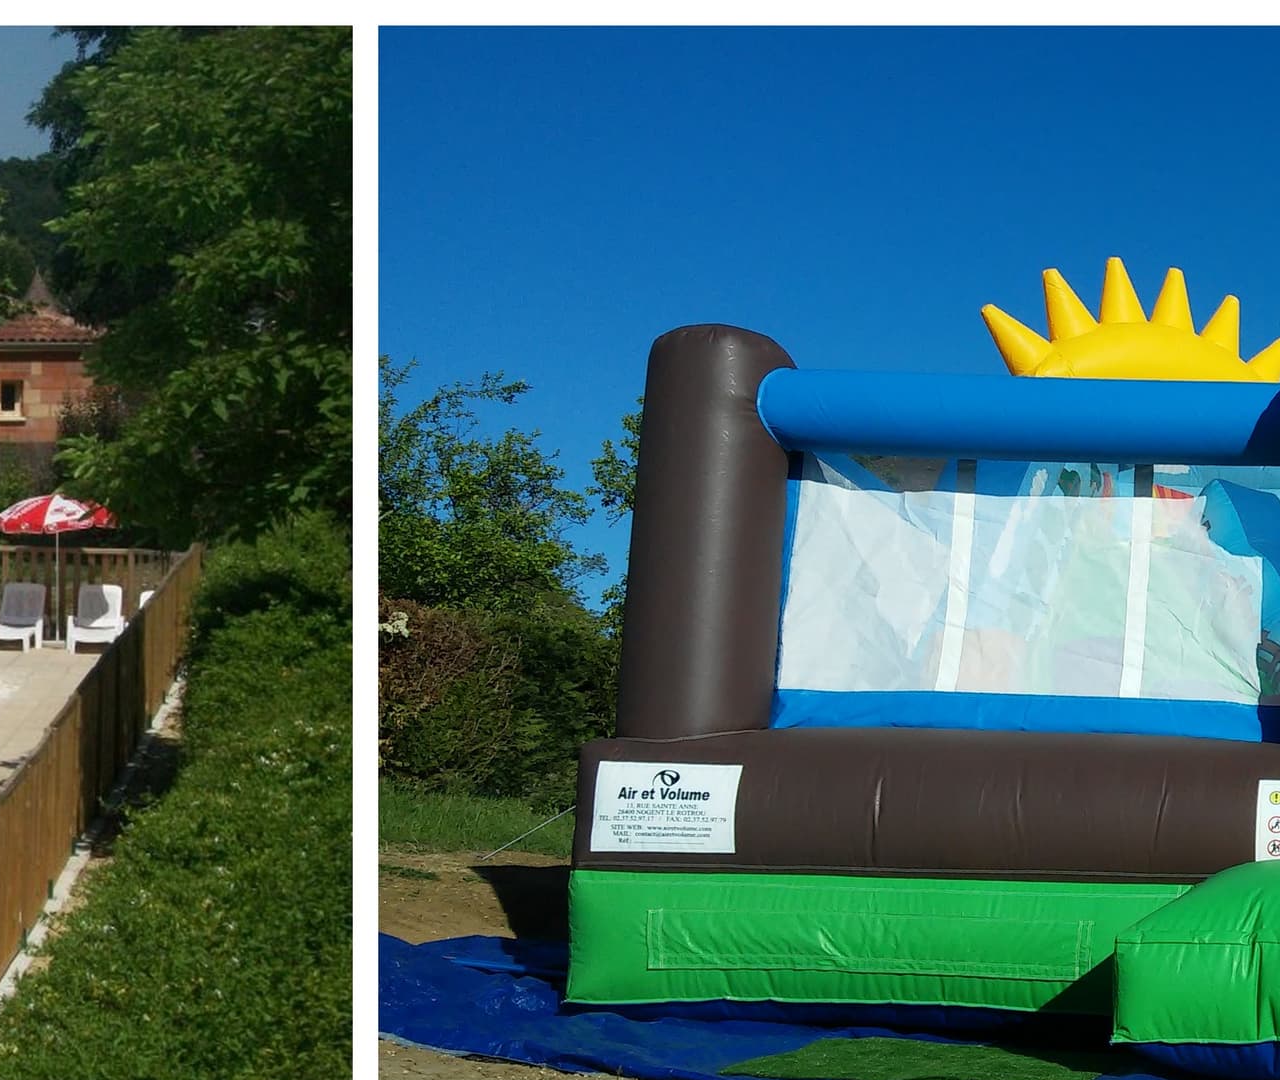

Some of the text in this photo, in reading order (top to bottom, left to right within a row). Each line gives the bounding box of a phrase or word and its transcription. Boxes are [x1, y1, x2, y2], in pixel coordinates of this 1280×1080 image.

[617, 787, 710, 801] Air et Volume
